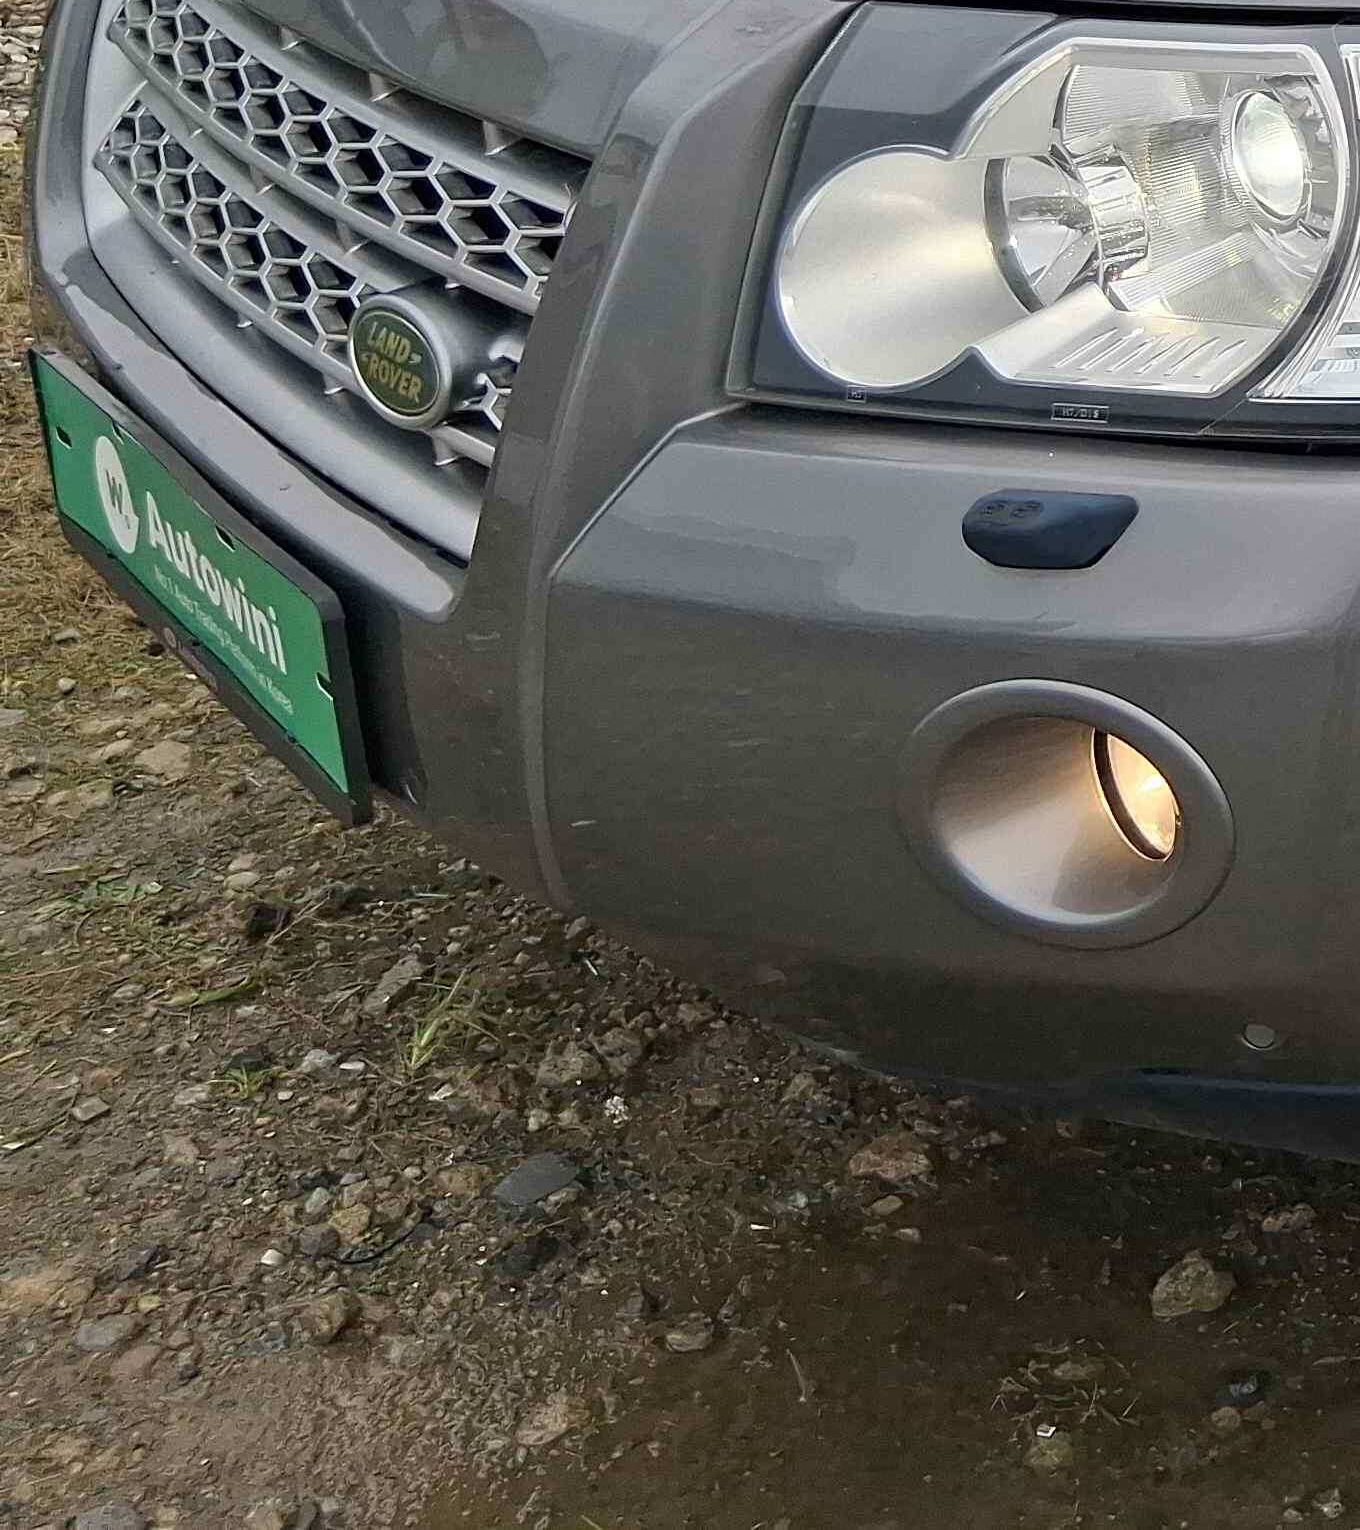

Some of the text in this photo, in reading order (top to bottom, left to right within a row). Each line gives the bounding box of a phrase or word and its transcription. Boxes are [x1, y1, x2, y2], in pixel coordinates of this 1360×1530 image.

[367, 321, 412, 364] LAND
[367, 351, 421, 404] ROVER
[145, 489, 288, 676] Autowini
